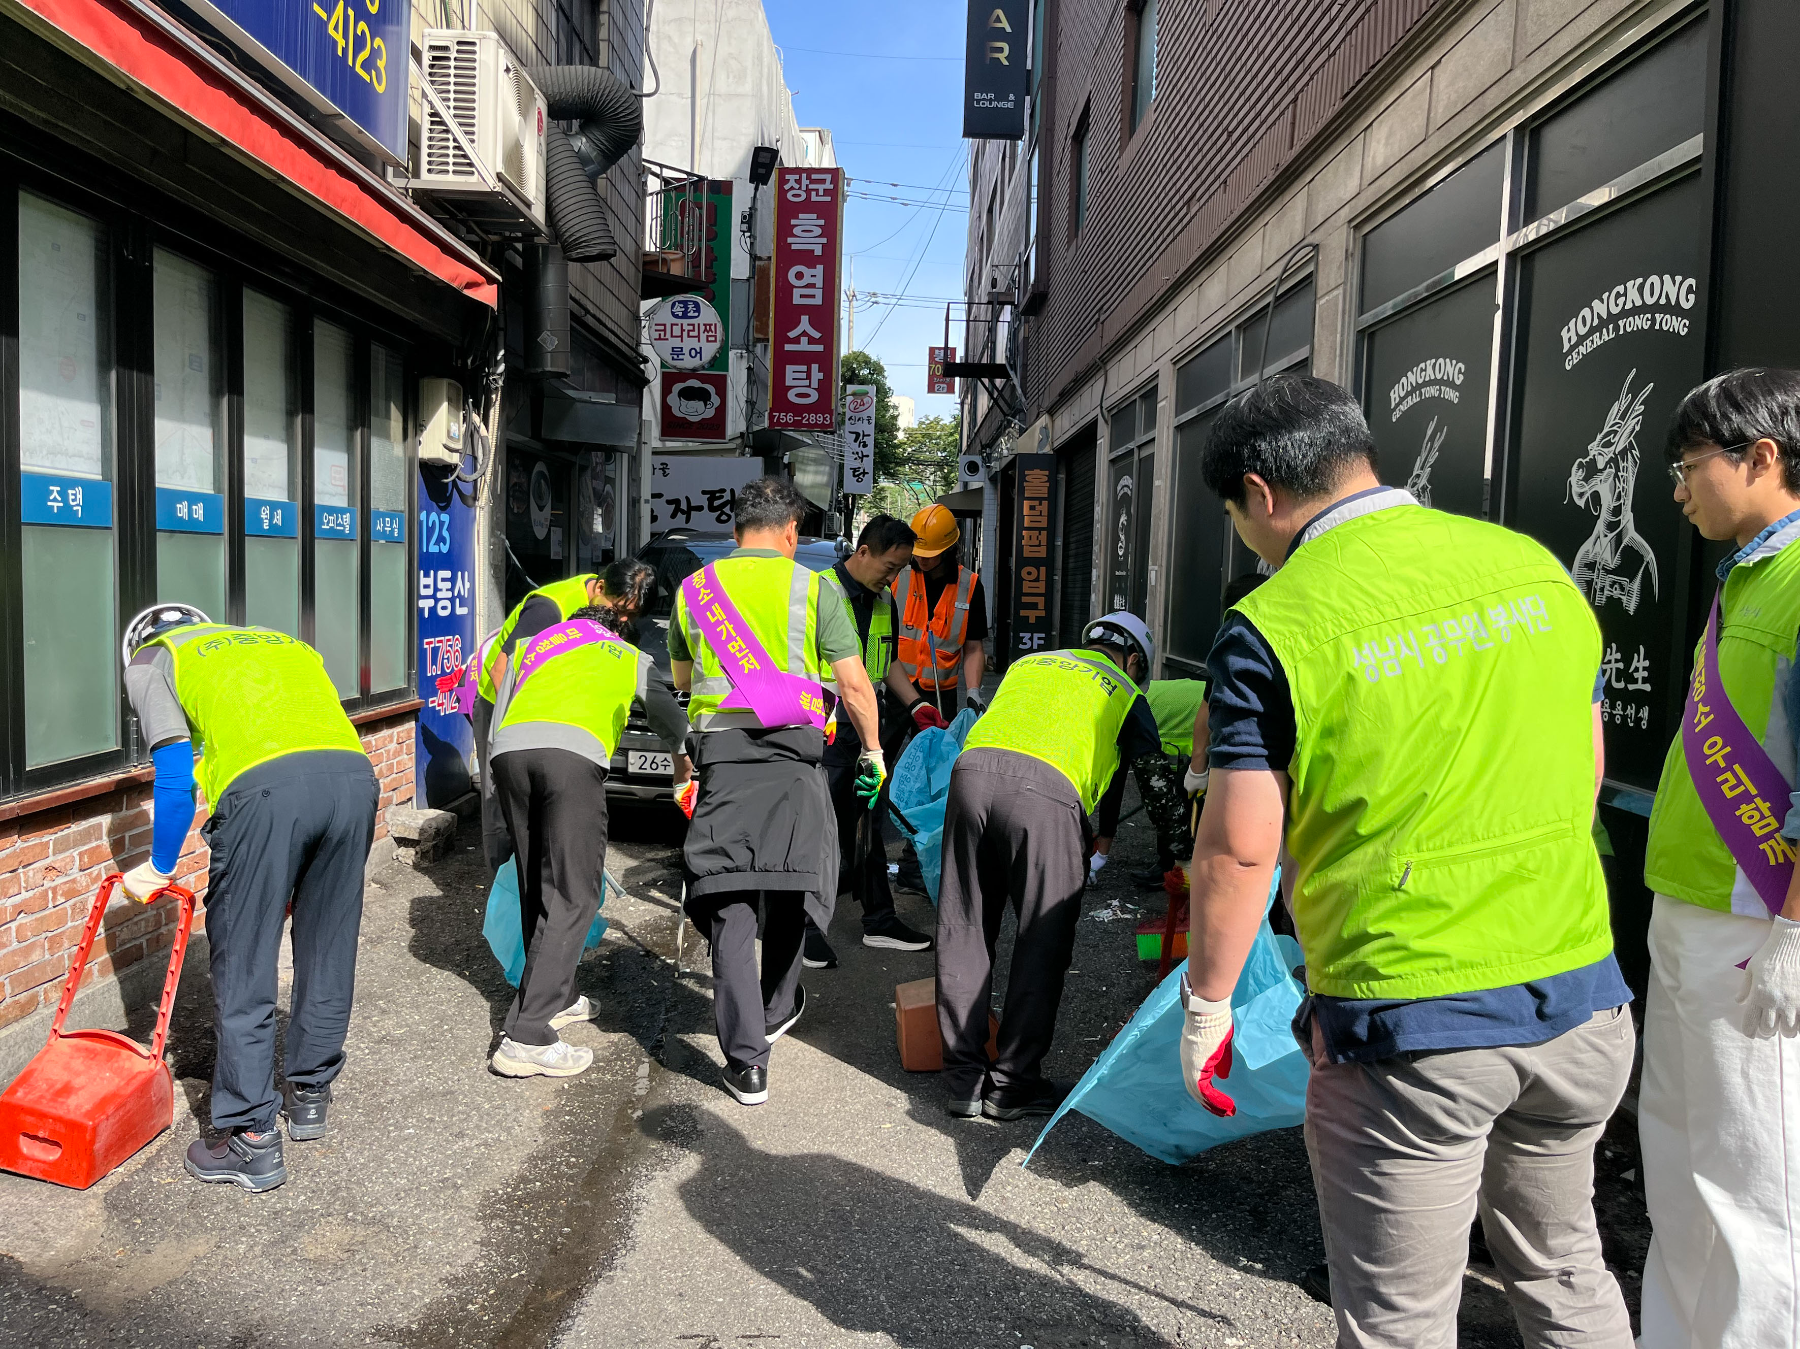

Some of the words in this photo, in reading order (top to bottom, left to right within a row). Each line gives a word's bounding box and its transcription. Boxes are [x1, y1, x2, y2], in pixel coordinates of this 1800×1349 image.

[313, 0, 387, 93] -4123
[974, 92, 995, 100] BAR
[1008, 93, 1015, 101] &
[974, 100, 1015, 109] LOUNGE
[783, 173, 834, 202] 장군
[671, 302, 699, 317] 속초
[784, 213, 828, 404] 흑염소탕
[1561, 274, 1696, 353] HONGKONG
[653, 322, 718, 343] 코다리찜
[1564, 323, 1616, 371] GENERAL
[1618, 313, 1651, 335] YONG
[1654, 313, 1690, 336] YONG
[670, 346, 703, 361] 문어
[1389, 357, 1465, 409] HONGKONG
[772, 412, 831, 424] 756-2893
[1391, 390, 1420, 422] GENERAL
[1421, 385, 1440, 400] YONG
[1440, 385, 1460, 404] YONG
[46, 485, 83, 518] 주택
[176, 500, 204, 522] 매매
[260, 505, 282, 530] 월세
[321, 512, 351, 534] 오피스텔
[376, 517, 399, 537] 사무실
[419, 510, 451, 554] 123
[418, 569, 471, 619] 부동산
[1020, 566, 1047, 623] 입구
[706, 602, 761, 674] 내가먼저
[1018, 632, 1046, 650] 3F
[1352, 629, 1425, 684] 성남시
[1421, 611, 1495, 665] 공무원
[1487, 593, 1553, 643] 봉사단
[423, 634, 462, 677] T.756
[638, 754, 671, 771] 26수
